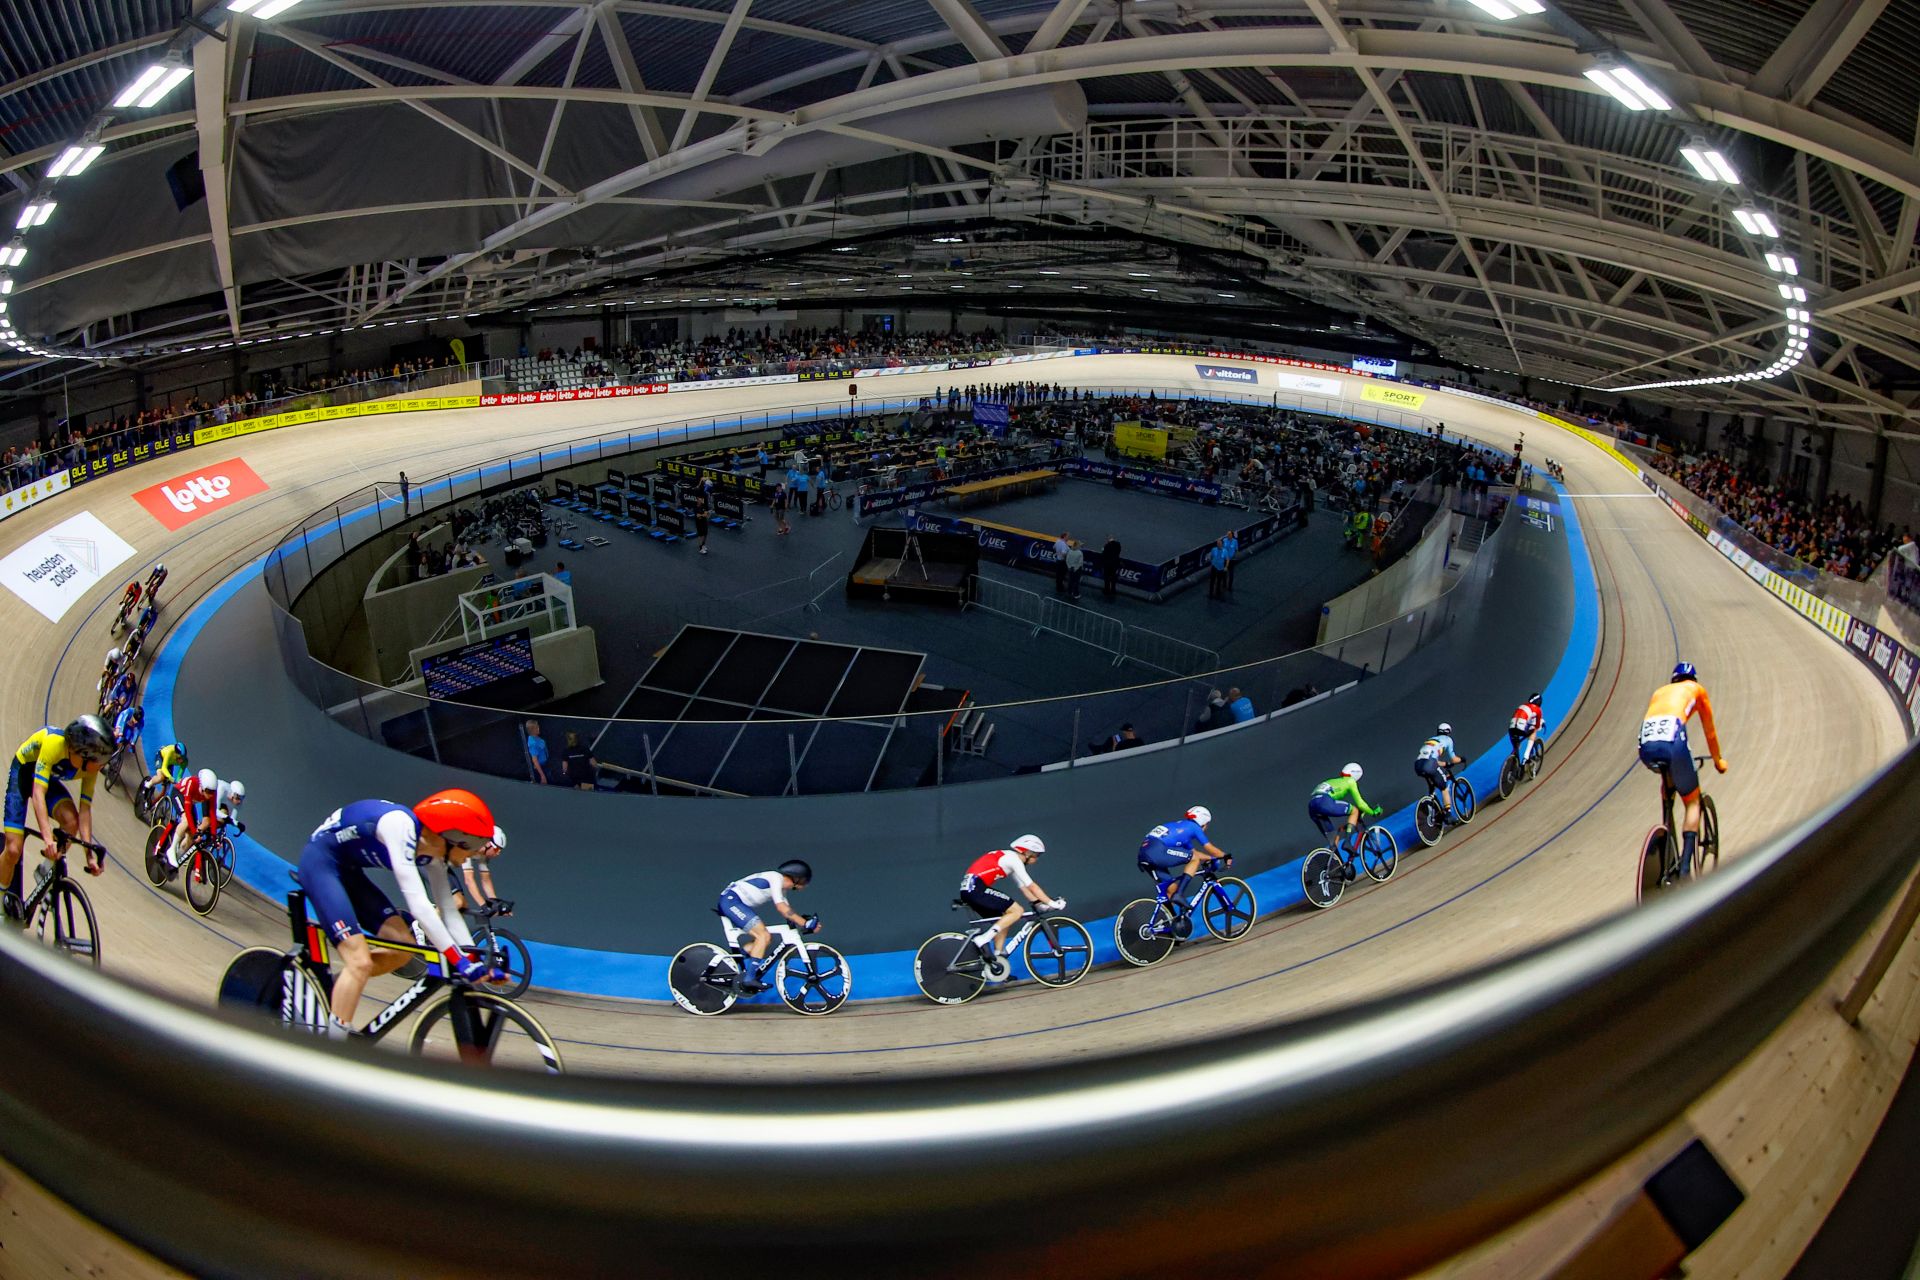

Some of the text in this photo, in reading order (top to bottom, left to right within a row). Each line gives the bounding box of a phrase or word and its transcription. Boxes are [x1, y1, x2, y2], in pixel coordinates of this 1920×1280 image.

[1216, 370, 1251, 379] vittoria
[520, 394, 536, 402] lotto
[540, 393, 556, 401] lotto
[578, 390, 593, 398] lotto
[597, 388, 612, 396] lotto
[616, 387, 631, 395] lotto
[634, 386, 648, 394] lotto
[652, 385, 666, 393] lotto
[1384, 392, 1416, 402] SPORT
[160, 475, 231, 512] lotto
[1158, 478, 1182, 488] vittoria
[1194, 484, 1218, 496] vittoria
[718, 502, 740, 512] GARMIN
[925, 522, 941, 531] UEC
[988, 538, 1007, 548] UEC
[1119, 568, 1142, 580] UEC
[22, 552, 66, 582] heusden
[50, 562, 78, 588] zolder
[178, 844, 197, 864] CANYON
[729, 906, 747, 920] ISRAEL
[1005, 921, 1034, 954] BMC
[760, 942, 786, 971] DOLAN
[369, 978, 428, 1034] LOOK
